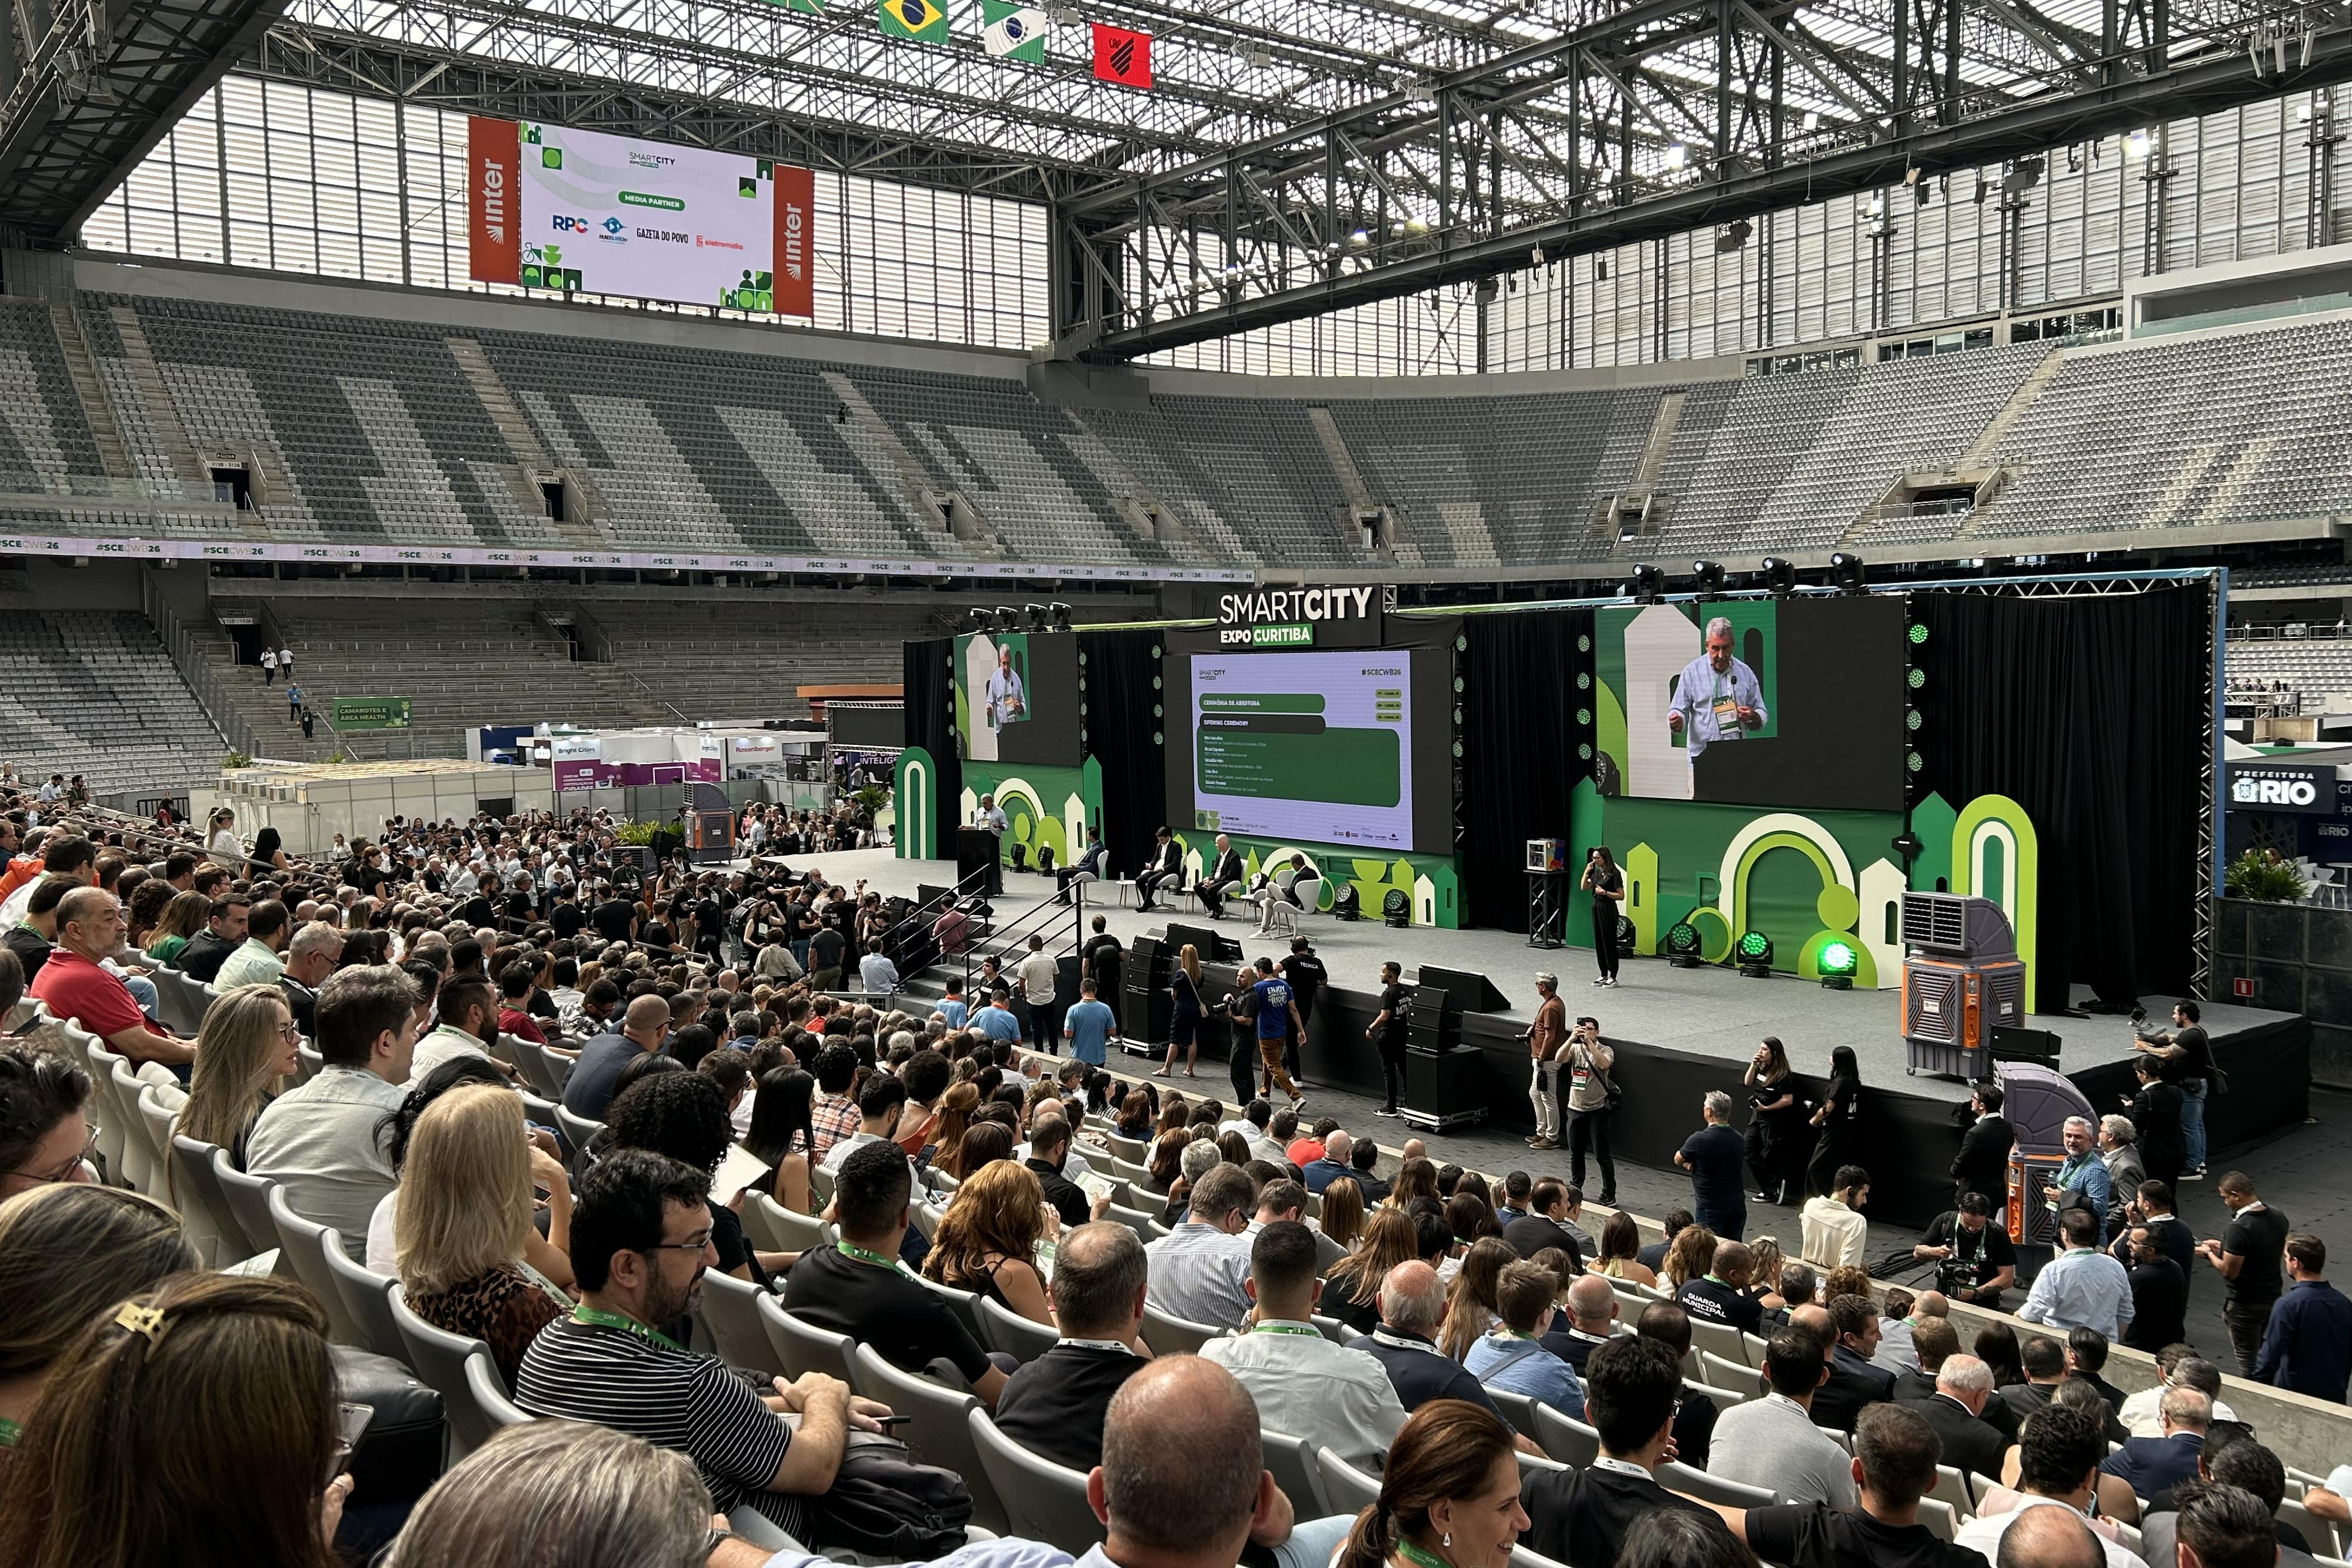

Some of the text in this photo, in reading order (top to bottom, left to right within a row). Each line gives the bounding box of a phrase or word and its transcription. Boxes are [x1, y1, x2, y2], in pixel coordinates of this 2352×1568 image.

[629, 152, 676, 165] SMARTCITY
[625, 195, 680, 208] MEDIA PARTNER
[552, 215, 588, 234] RPC
[636, 228, 689, 244] GAZETA DO POVO
[705, 239, 744, 250] eletromidia
[96, 544, 160, 552] #SCECWB26
[203, 547, 264, 555] #SCECWB26
[303, 549, 360, 557] #SCECWB26
[398, 551, 452, 559] #SCECWB26
[1220, 586, 1373, 624] SMARTCITY
[1220, 626, 1311, 643] EXPO CURITIBA
[2235, 771, 2315, 780] PREFEITURA
[2259, 780, 2316, 806] RIO
[2328, 827, 2350, 836] RIO
[1267, 985, 1285, 995] ENJOY
[1272, 995, 1286, 1004] RIDE
[1682, 1296, 1727, 1318] MUNICIPAL
[1688, 1292, 1722, 1310] GUARDA
